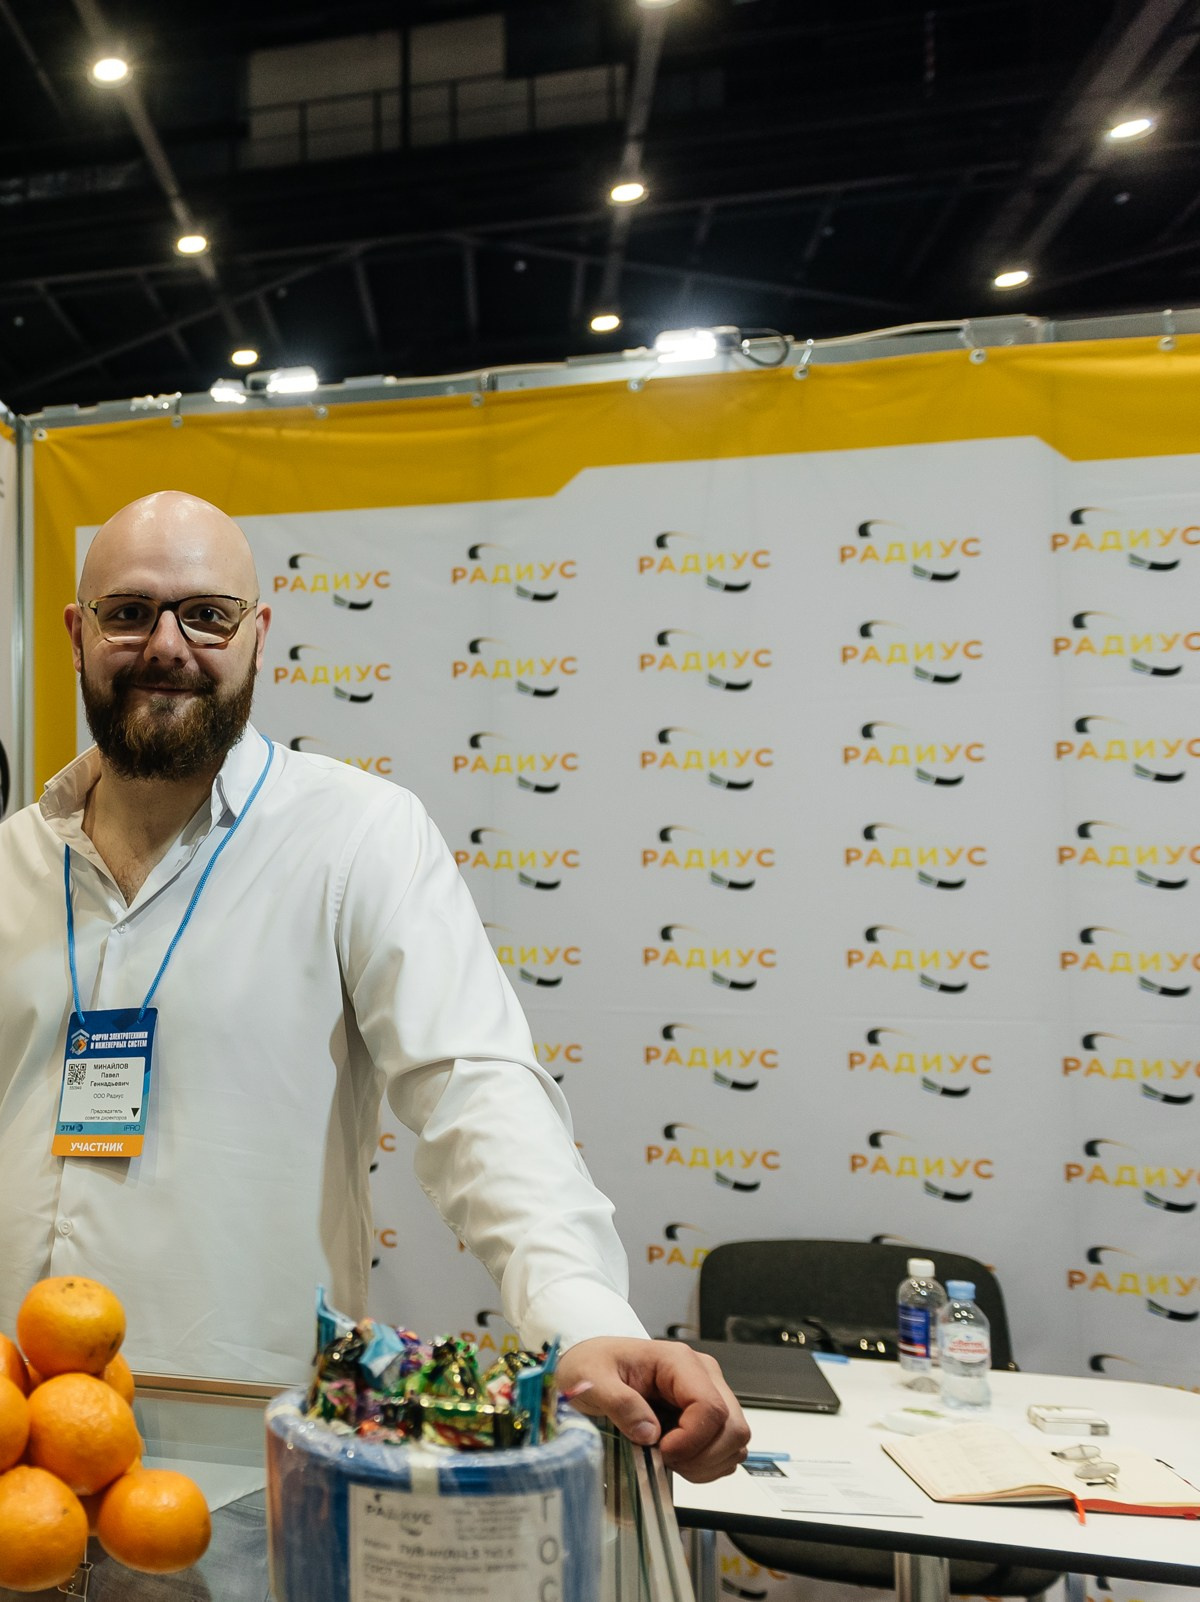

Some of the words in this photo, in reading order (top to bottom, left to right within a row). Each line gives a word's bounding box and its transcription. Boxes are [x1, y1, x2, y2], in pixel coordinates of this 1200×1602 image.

[838, 537, 980, 565] РАДИУС
[1049, 525, 1200, 553] РАДИУС
[451, 560, 575, 585] РАДИУС
[637, 549, 769, 575] РАДИУС
[273, 569, 389, 595] РАДИУС
[840, 639, 982, 666] РАДИУС
[1052, 631, 1200, 658] РАДИУС
[452, 656, 577, 681] РАДИУС
[638, 648, 771, 673] РАДИУС
[274, 663, 390, 687] РАДИУС
[453, 752, 577, 775] РАДИУС
[639, 747, 773, 772] РАДИУС
[842, 742, 984, 768] РАДИУС
[454, 849, 579, 871] РАДИУС
[641, 847, 774, 871] РАДИУС
[843, 845, 986, 870] РАДИУС
[497, 945, 580, 968] ДИУС
[642, 947, 776, 970] РАДИУС
[845, 949, 988, 973] РАДИУС
[127, 1039, 148, 1048] СИСТЕМ
[644, 1046, 777, 1070] РАДИУС
[847, 1051, 990, 1077] РАДИУС
[1061, 1056, 1200, 1081] РАДИУ
[90, 1080, 130, 1088] Геннадьевич
[60, 1124, 75, 1132] ЭТМ
[70, 1142, 124, 1152] УЧАСТНИК
[645, 1145, 779, 1170] РАДИУС
[849, 1154, 993, 1180] РАДИУС
[1064, 1163, 1200, 1189] РАДИУ
[1067, 1270, 1200, 1297] РАДИУ
